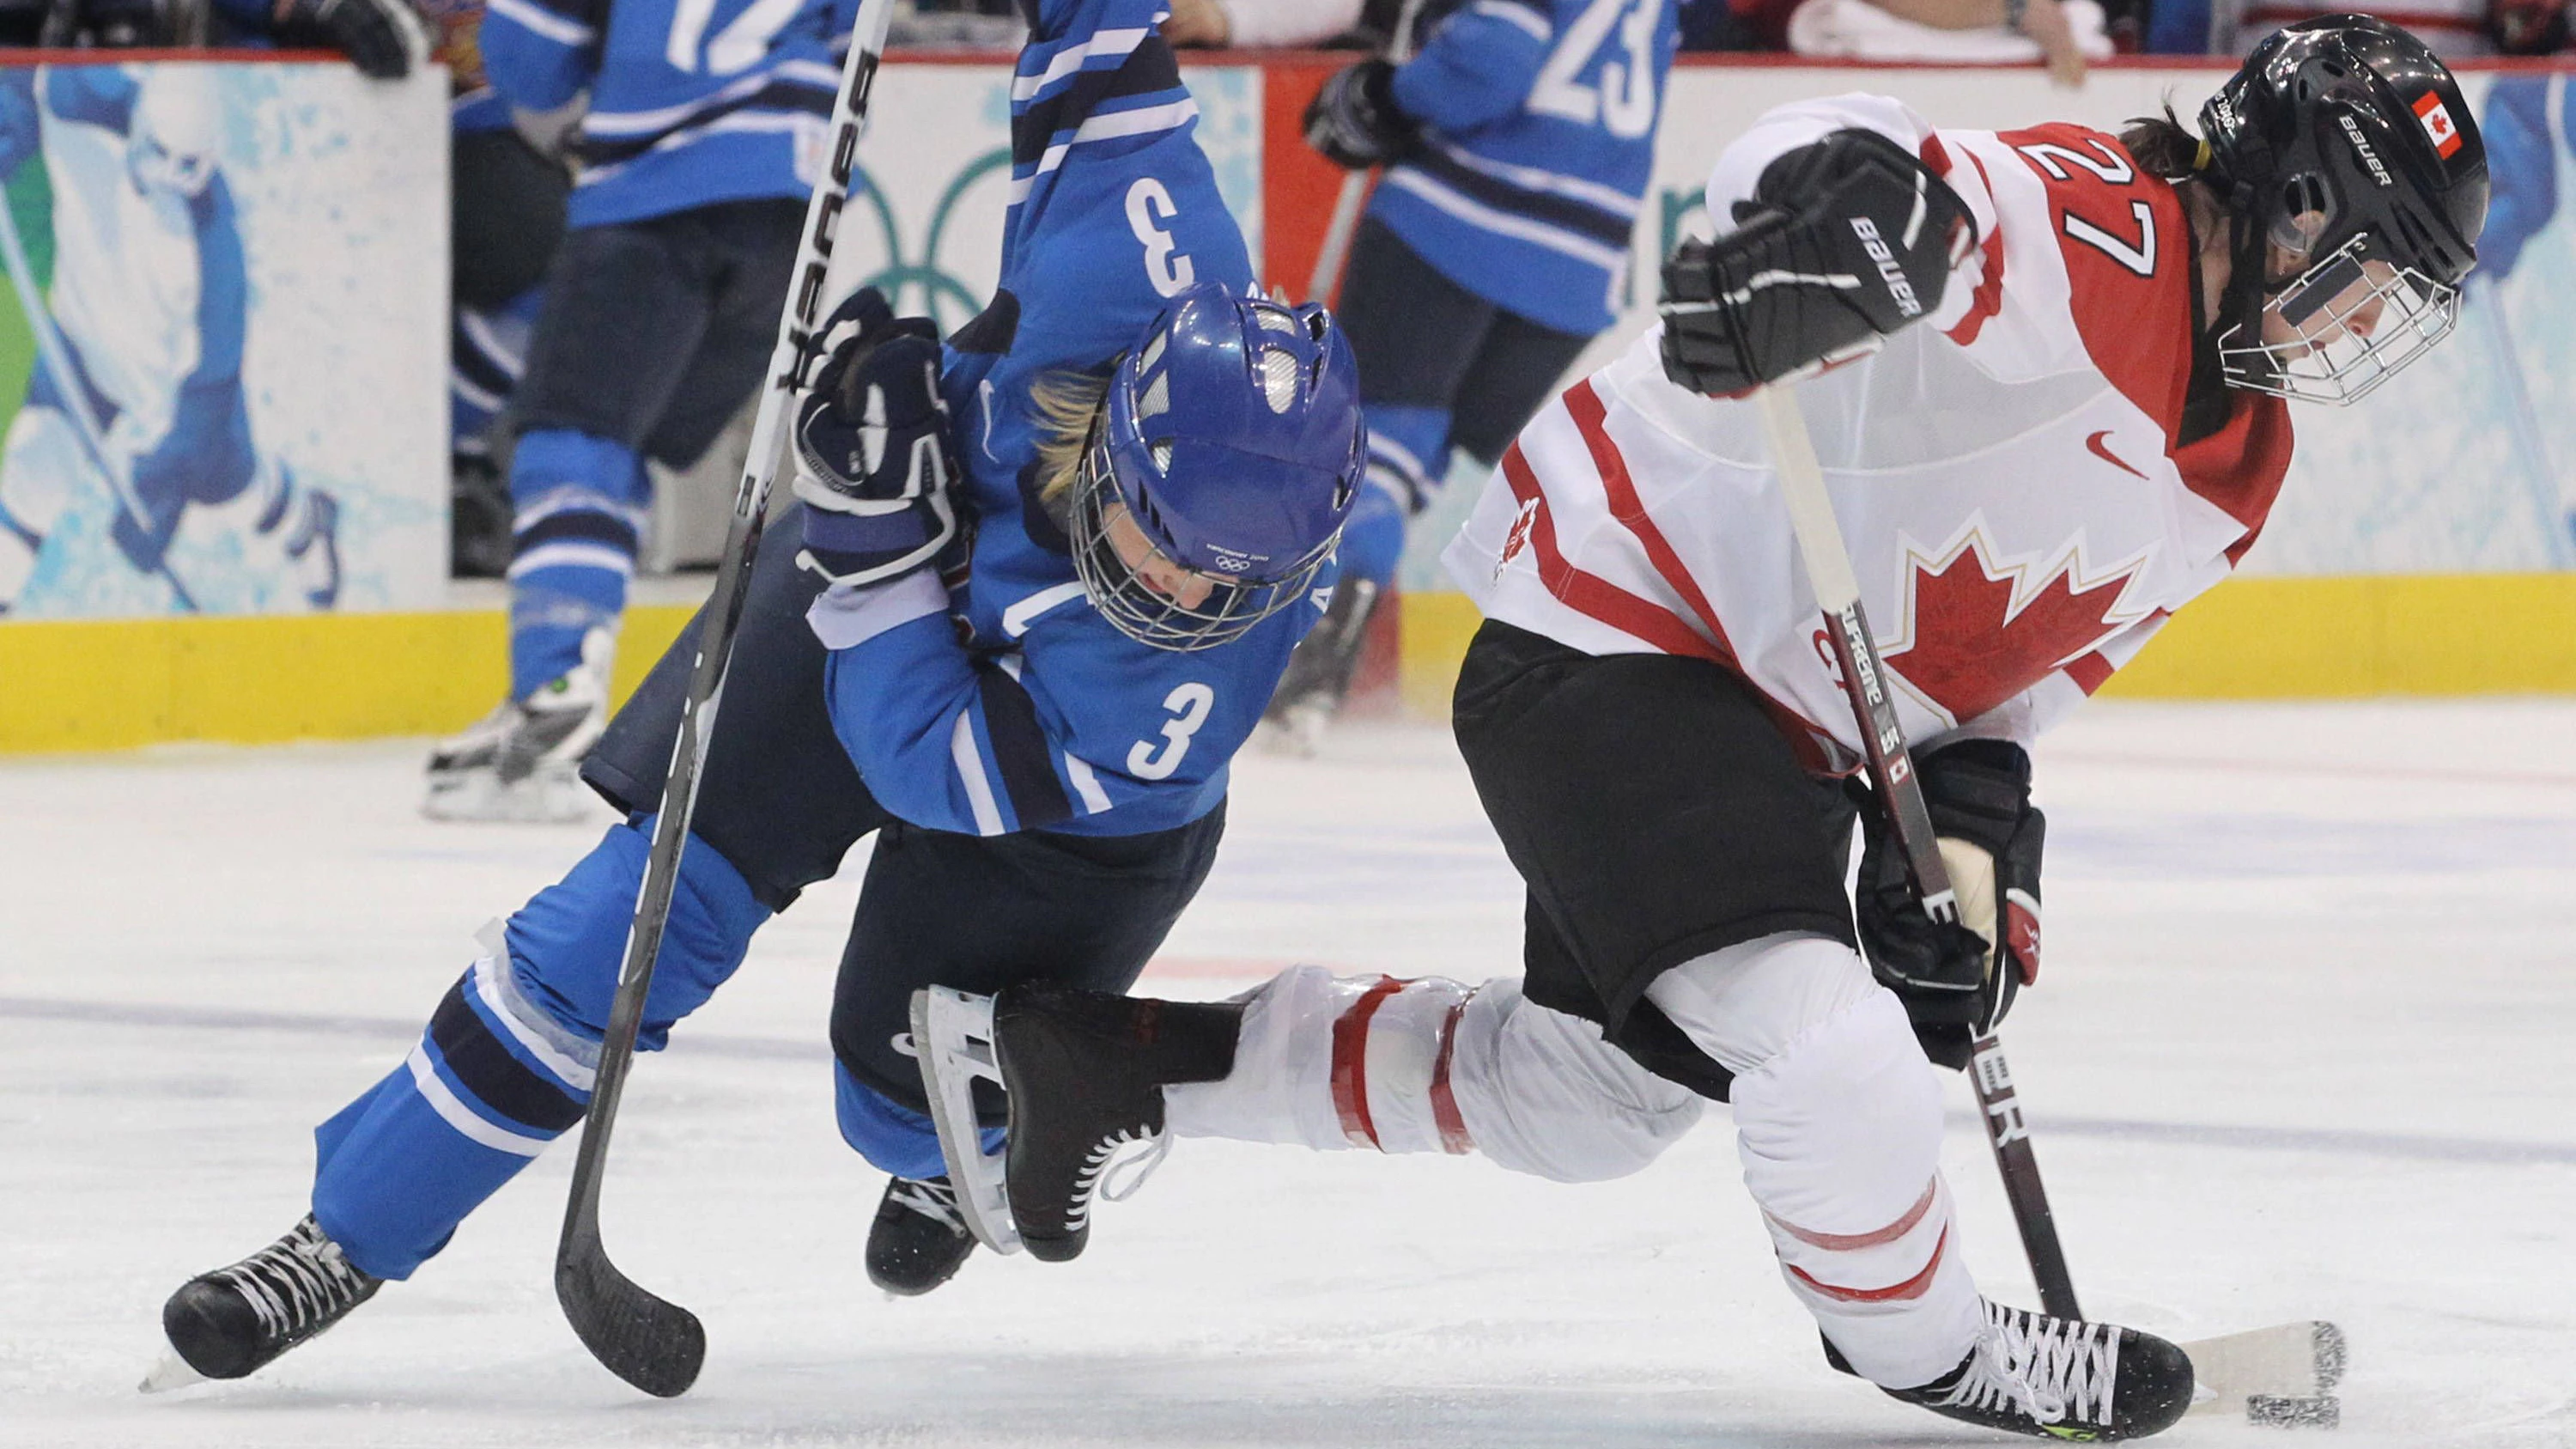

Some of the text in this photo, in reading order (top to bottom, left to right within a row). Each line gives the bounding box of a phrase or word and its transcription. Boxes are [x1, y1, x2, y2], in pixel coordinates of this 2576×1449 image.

[1525, 0, 1662, 139] 23
[2339, 115, 2392, 186] BAUER
[1125, 177, 1195, 299] 3
[2016, 138, 2157, 279] 27
[1849, 216, 1923, 318] BAUER
[1127, 681, 1215, 781] 3
